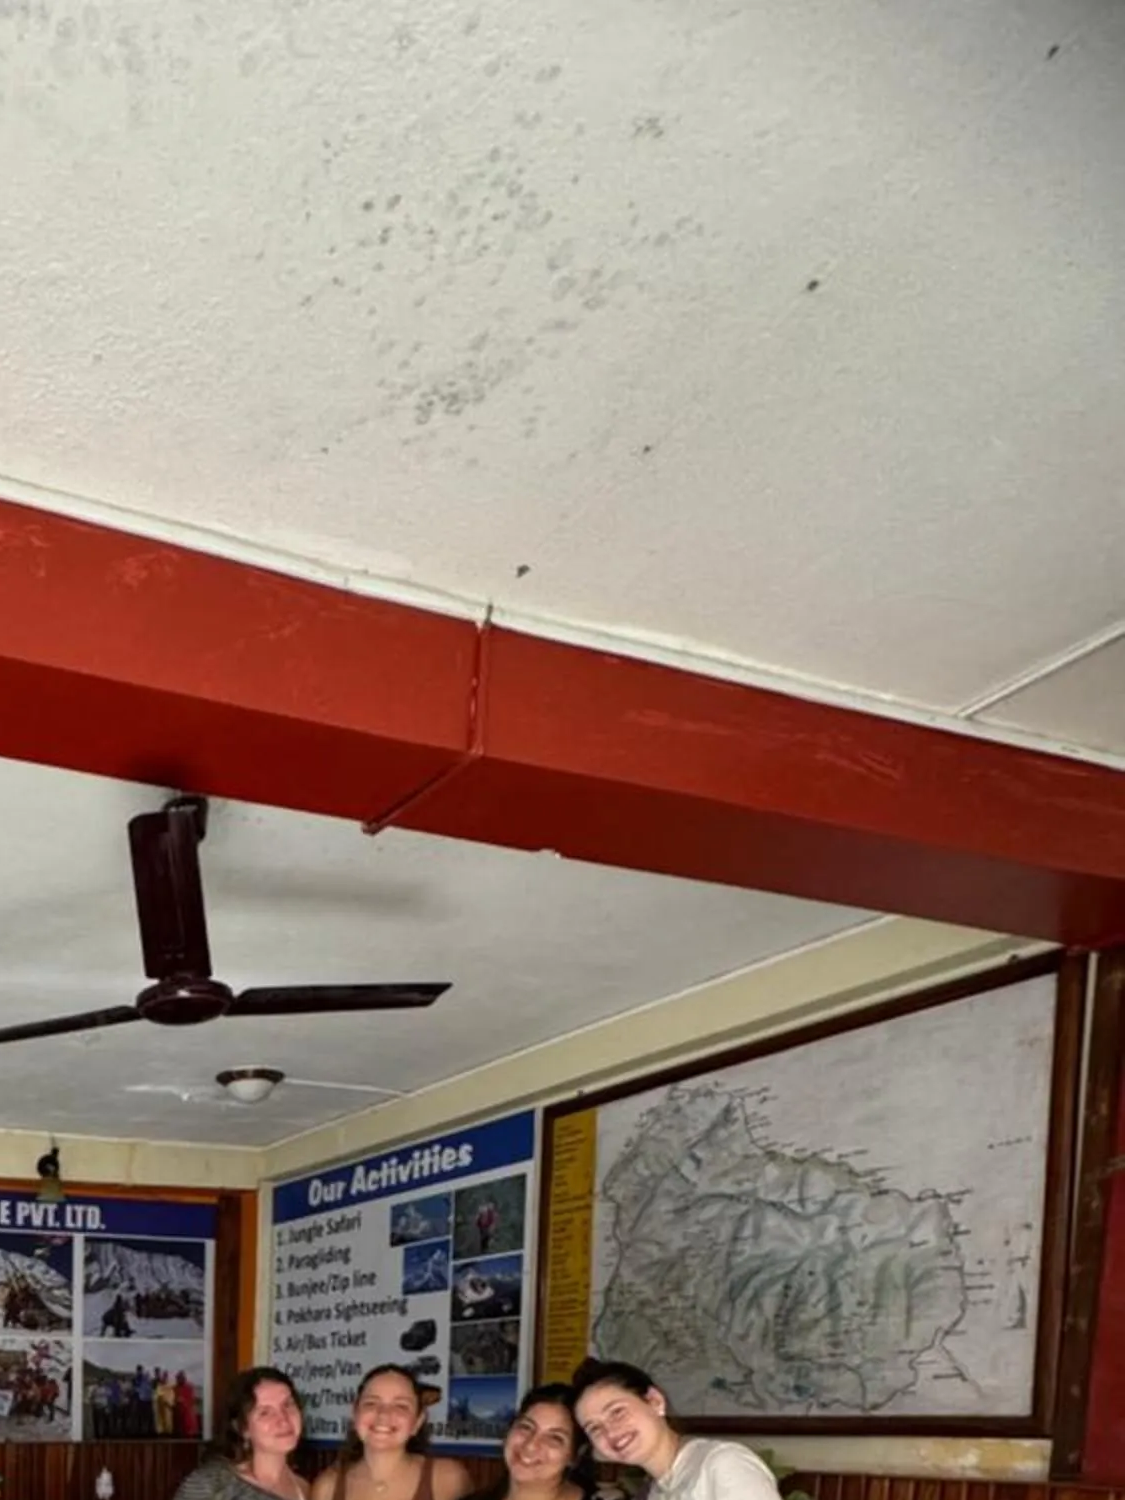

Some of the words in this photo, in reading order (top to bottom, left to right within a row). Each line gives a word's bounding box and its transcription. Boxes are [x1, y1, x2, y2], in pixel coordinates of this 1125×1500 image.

[307, 1178, 346, 1207] Our
[350, 1142, 474, 1197] Activities
[15, 1200, 61, 1228] PVT.
[65, 1204, 106, 1231] LTD.
[289, 1220, 324, 1244] Jungle
[326, 1208, 362, 1236] Safari
[287, 1246, 352, 1271] Paragliding
[286, 1303, 332, 1324] Pokhara
[333, 1294, 409, 1323] Sightseeing
[330, 1328, 367, 1349] Ticket
